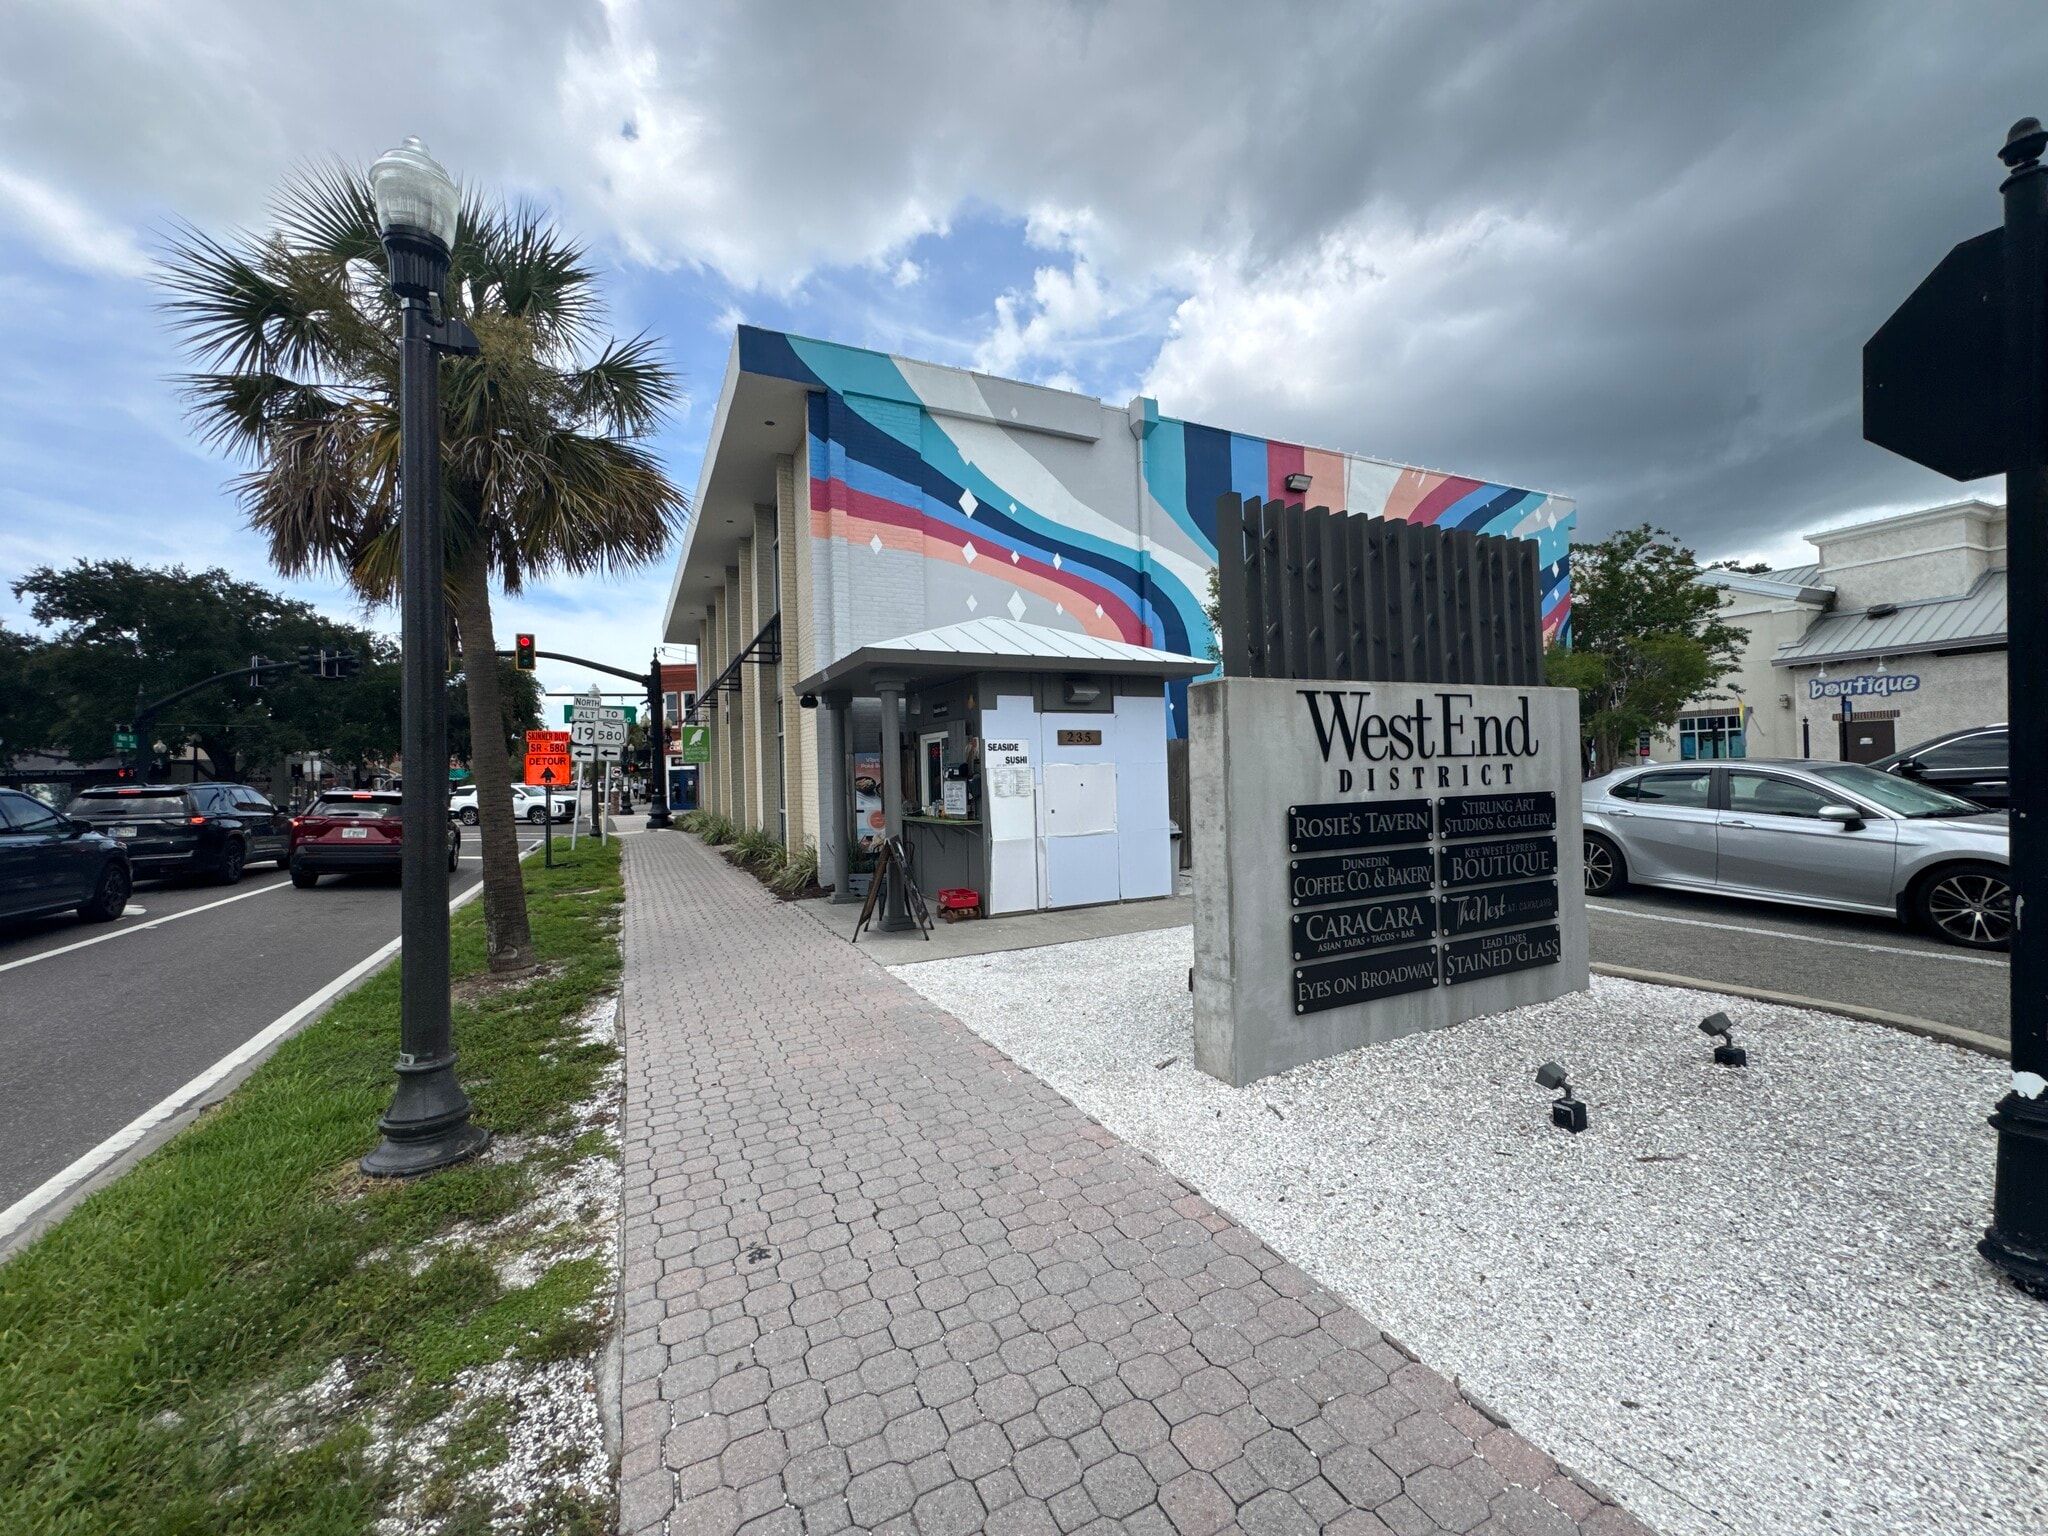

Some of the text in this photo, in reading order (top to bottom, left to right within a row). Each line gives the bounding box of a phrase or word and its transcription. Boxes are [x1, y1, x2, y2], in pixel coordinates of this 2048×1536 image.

[1810, 676, 1918, 698] boutique
[576, 698, 600, 708] NORTH
[578, 711, 595, 719] ALT
[605, 711, 618, 719] TO
[528, 731, 569, 742] SKINNER BLVD
[577, 727, 593, 740] 19
[598, 731, 622, 741] 580
[1067, 732, 1091, 743] 235
[530, 744, 542, 752] SR
[549, 744, 565, 752] 580
[987, 743, 1019, 752] SEASIDE
[529, 757, 566, 765] DETOUR
[1005, 756, 1028, 765] SUSHI
[1339, 764, 1514, 793] DISTRICT
[1461, 799, 1535, 816] STIRLING ART
[1294, 812, 1429, 838] ROSIE'S TAVERN
[1445, 813, 1552, 833] STUDIOS & GALLERY
[1464, 842, 1537, 859] KEY WEST EXPRESS
[1342, 856, 1390, 871] DUNEDIN
[1452, 851, 1550, 881] BOUTIQUE
[1294, 865, 1432, 898] COFFEE CO. & BAKERY
[1317, 929, 1416, 952] ASIAN TAPAS TACOS BAR
[1482, 933, 1527, 950] LEAD LINES
[1446, 938, 1560, 977] STAINED GLASS
[1298, 962, 1435, 1002] EYES ON BROADWAY
